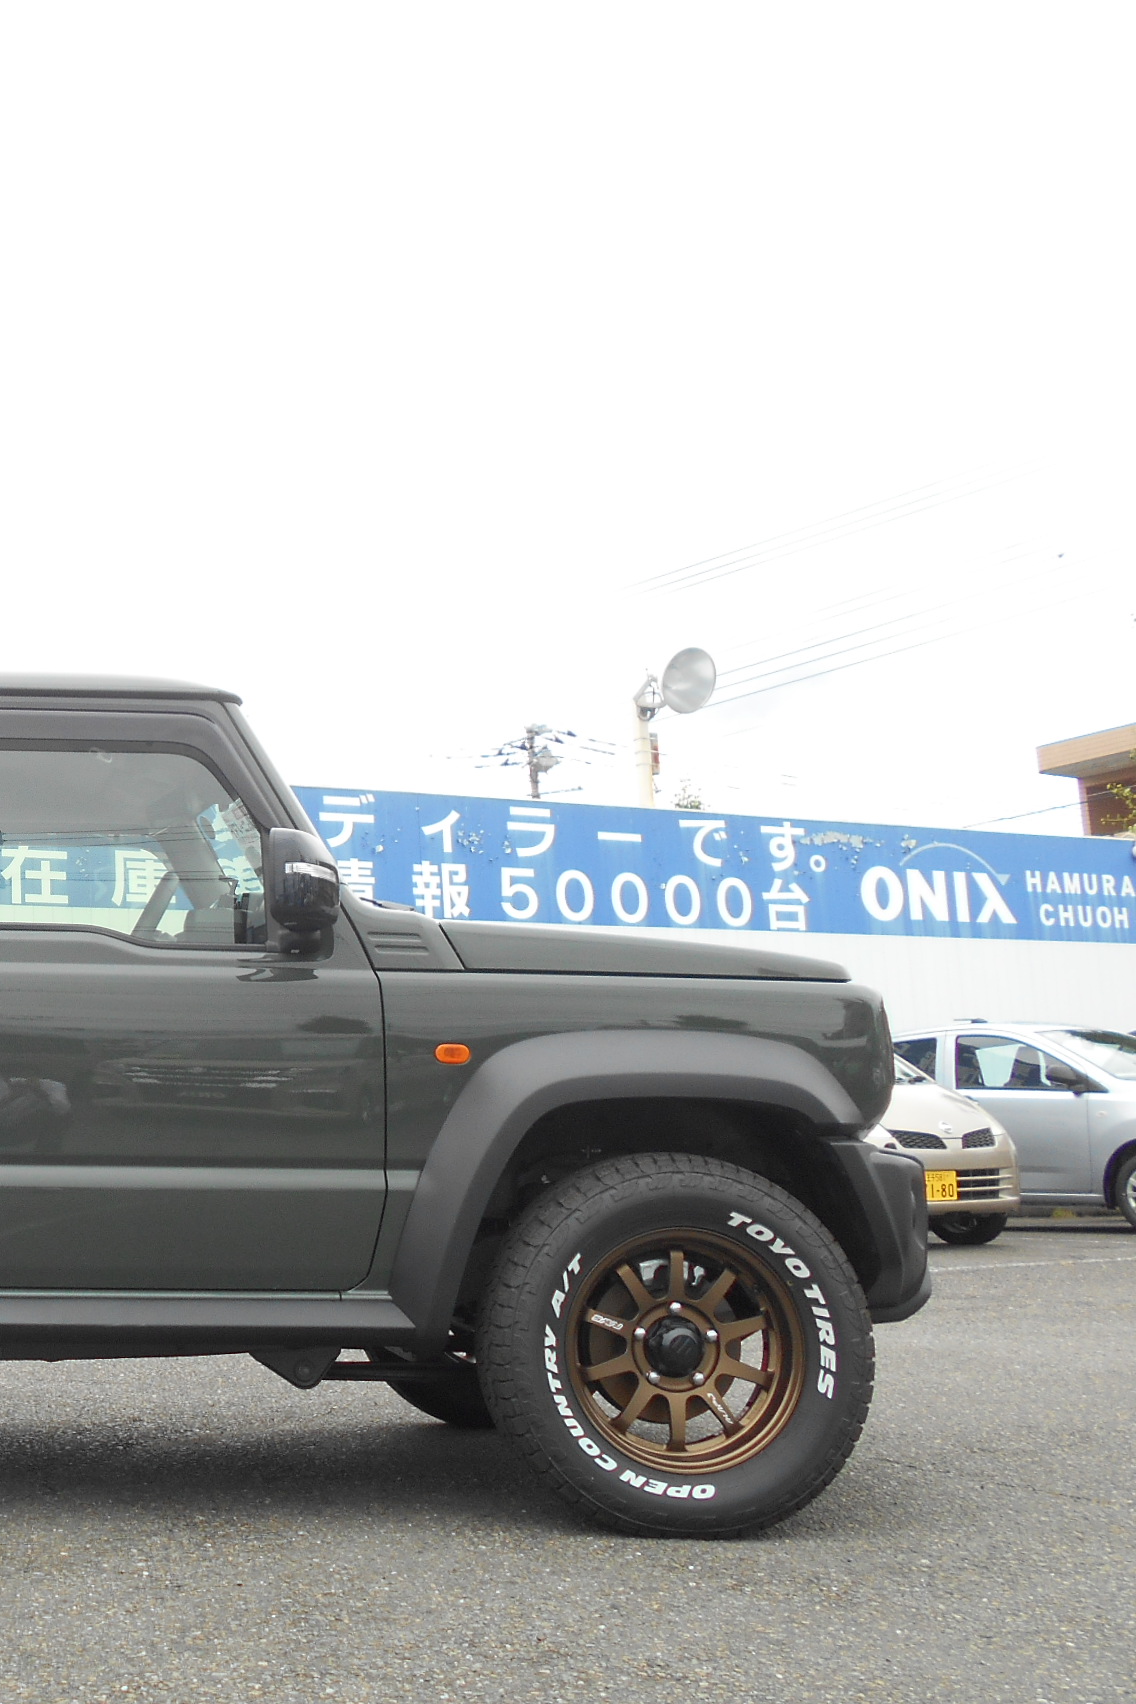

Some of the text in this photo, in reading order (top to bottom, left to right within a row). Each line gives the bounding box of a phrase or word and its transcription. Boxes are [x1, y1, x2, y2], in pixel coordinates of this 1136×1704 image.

[860, 865, 1018, 925] ONIX
[1025, 870, 1136, 897] HAMURA
[1039, 903, 1130, 929] CHUOH
[551, 1253, 581, 1318] A/T
[727, 1211, 838, 1399] TOYO TIRES
[544, 1324, 618, 1471] COUNTRY
[619, 1470, 717, 1500] OPEN
